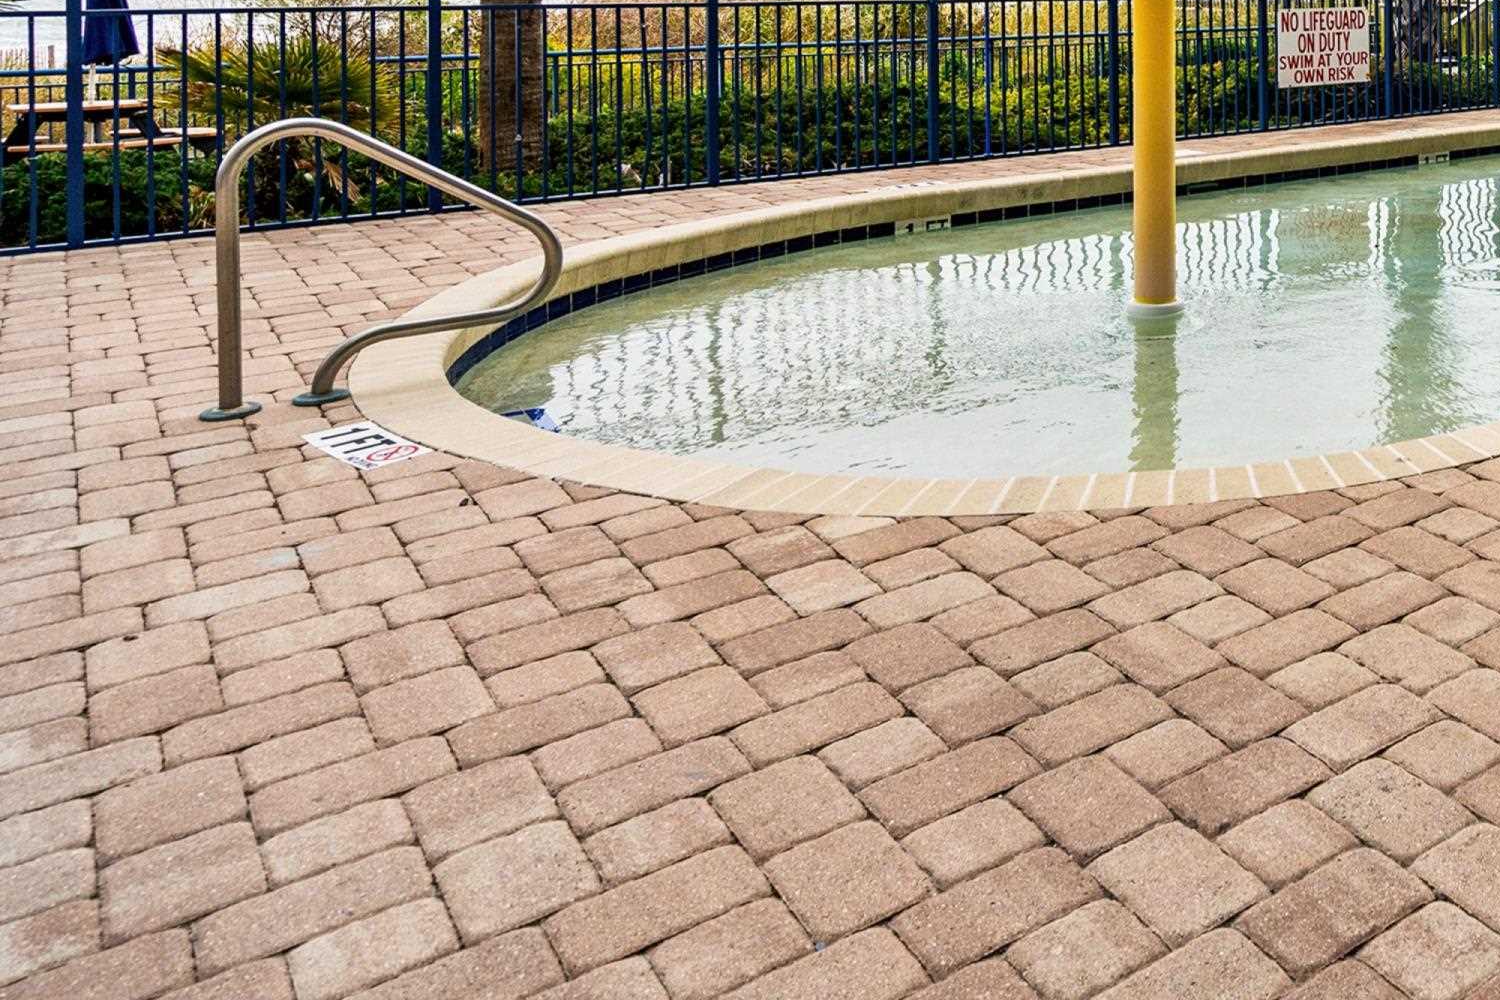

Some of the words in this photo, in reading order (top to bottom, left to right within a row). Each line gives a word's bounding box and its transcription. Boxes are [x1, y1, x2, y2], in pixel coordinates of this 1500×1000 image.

[1281, 12, 1299, 32] NO
[1303, 10, 1366, 31] LIFEGUARD
[1297, 33, 1315, 53] ON
[1320, 31, 1350, 52] DUTY
[1280, 55, 1313, 70] SWIM
[1318, 53, 1332, 67] AT
[1336, 51, 1368, 66] YOUR
[1294, 68, 1324, 84] OWN
[1328, 66, 1354, 81] RISK
[320, 428, 370, 441] 1
[330, 433, 398, 454] FT
